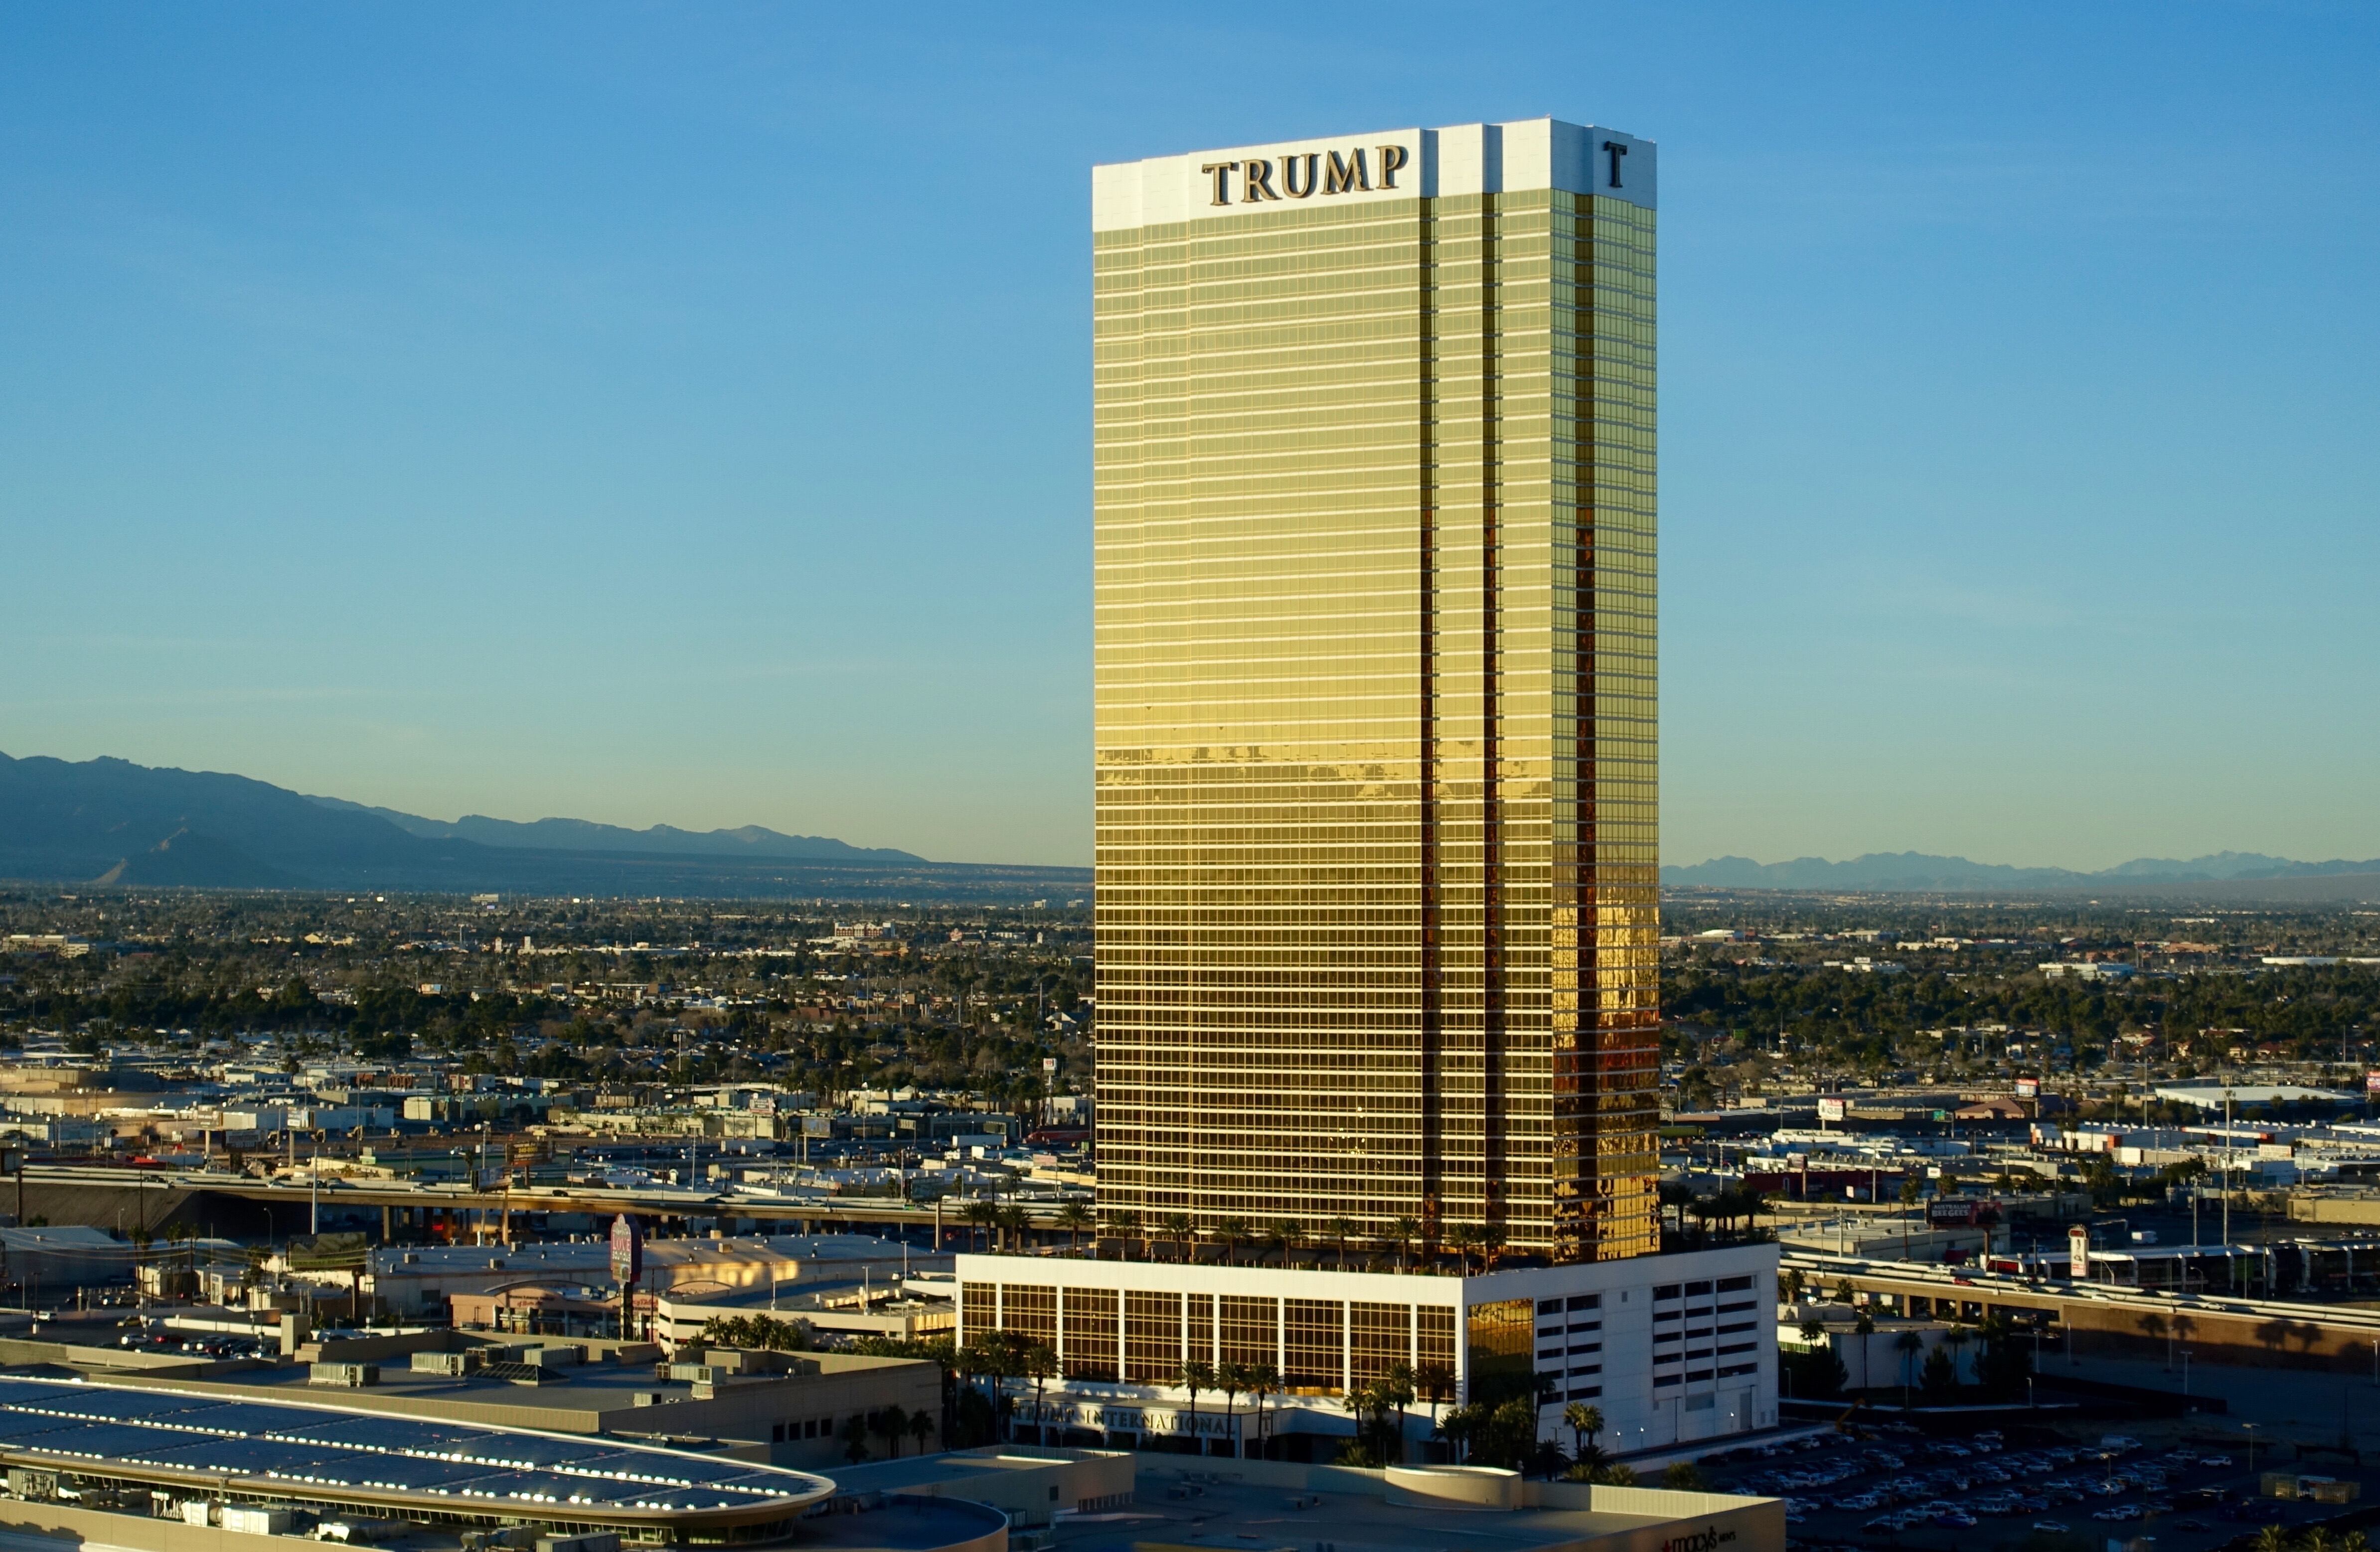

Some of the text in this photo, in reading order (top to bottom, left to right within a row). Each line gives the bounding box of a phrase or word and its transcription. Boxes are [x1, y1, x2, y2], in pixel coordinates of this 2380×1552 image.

[1202, 145, 1404, 206] TRUMP
[1605, 140, 1627, 188] T
[612, 1236, 631, 1252] LOVE
[1085, 1409, 1236, 1434] INTERNATIONAL
[1672, 1526, 1718, 1552] macy's
